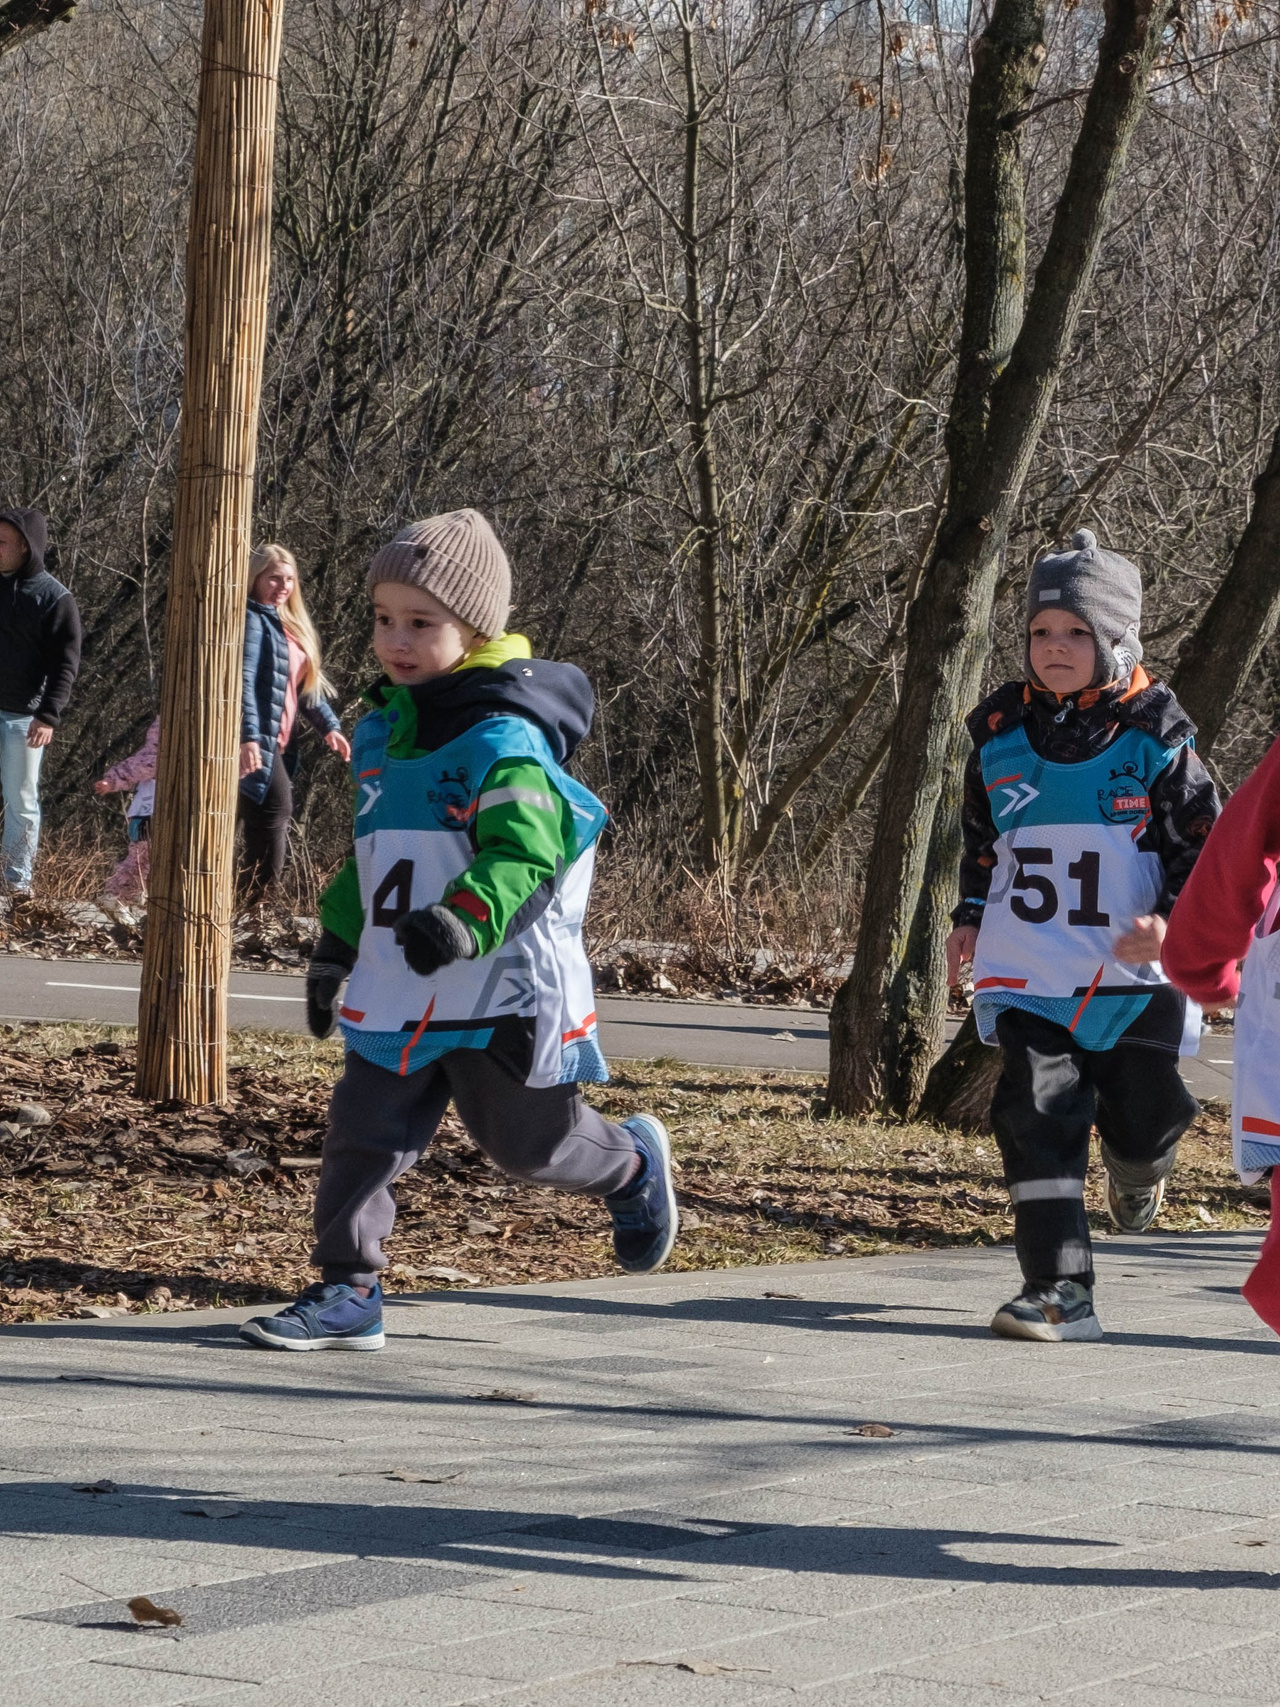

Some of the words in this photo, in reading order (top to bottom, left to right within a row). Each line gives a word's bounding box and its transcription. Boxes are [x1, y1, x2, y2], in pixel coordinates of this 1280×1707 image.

[1097, 786, 1134, 801] RACE
[1116, 798, 1146, 809] TIME
[372, 858, 415, 928] 4
[1010, 847, 1110, 927] 51
